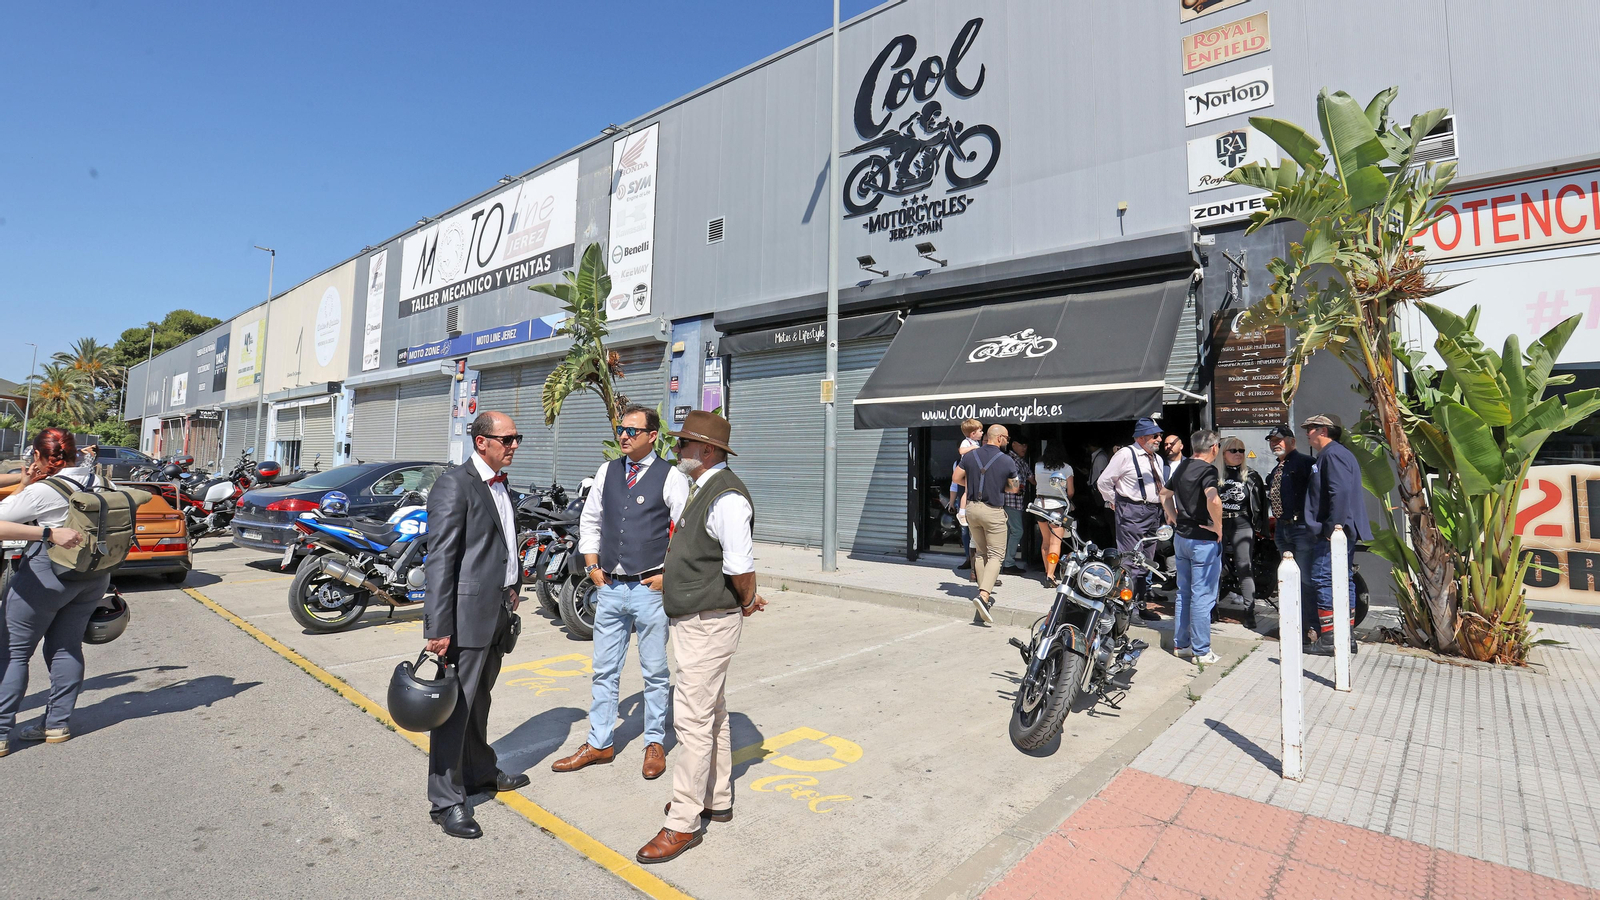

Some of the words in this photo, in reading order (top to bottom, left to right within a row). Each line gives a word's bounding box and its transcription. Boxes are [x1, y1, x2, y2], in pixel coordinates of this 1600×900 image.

[1193, 21, 1256, 50] ROYAL
[1187, 36, 1266, 70] ENFIELD
[854, 17, 986, 139] Cool
[1188, 80, 1269, 115] Norton
[621, 161, 649, 177] HONDA
[627, 175, 652, 194] SYM
[868, 194, 968, 235] MOTORCYCLES
[507, 227, 546, 256] JEREZ
[624, 241, 650, 257] Benelli
[411, 292, 439, 313] TALLER
[441, 275, 492, 303] MECANICO
[495, 271, 503, 287] Y
[505, 254, 551, 283] VENTAS
[476, 334, 490, 346] MOTO
[490, 331, 501, 343] LINE
[501, 328, 517, 341] JEREZ
[774, 332, 792, 344] Motos
[798, 325, 826, 343] Lifestyle
[408, 348, 425, 360] MOTO
[424, 345, 441, 357] ZONE
[921, 398, 1063, 422] www.COOLmotorcycles.es
[749, 774, 853, 813] Cool
